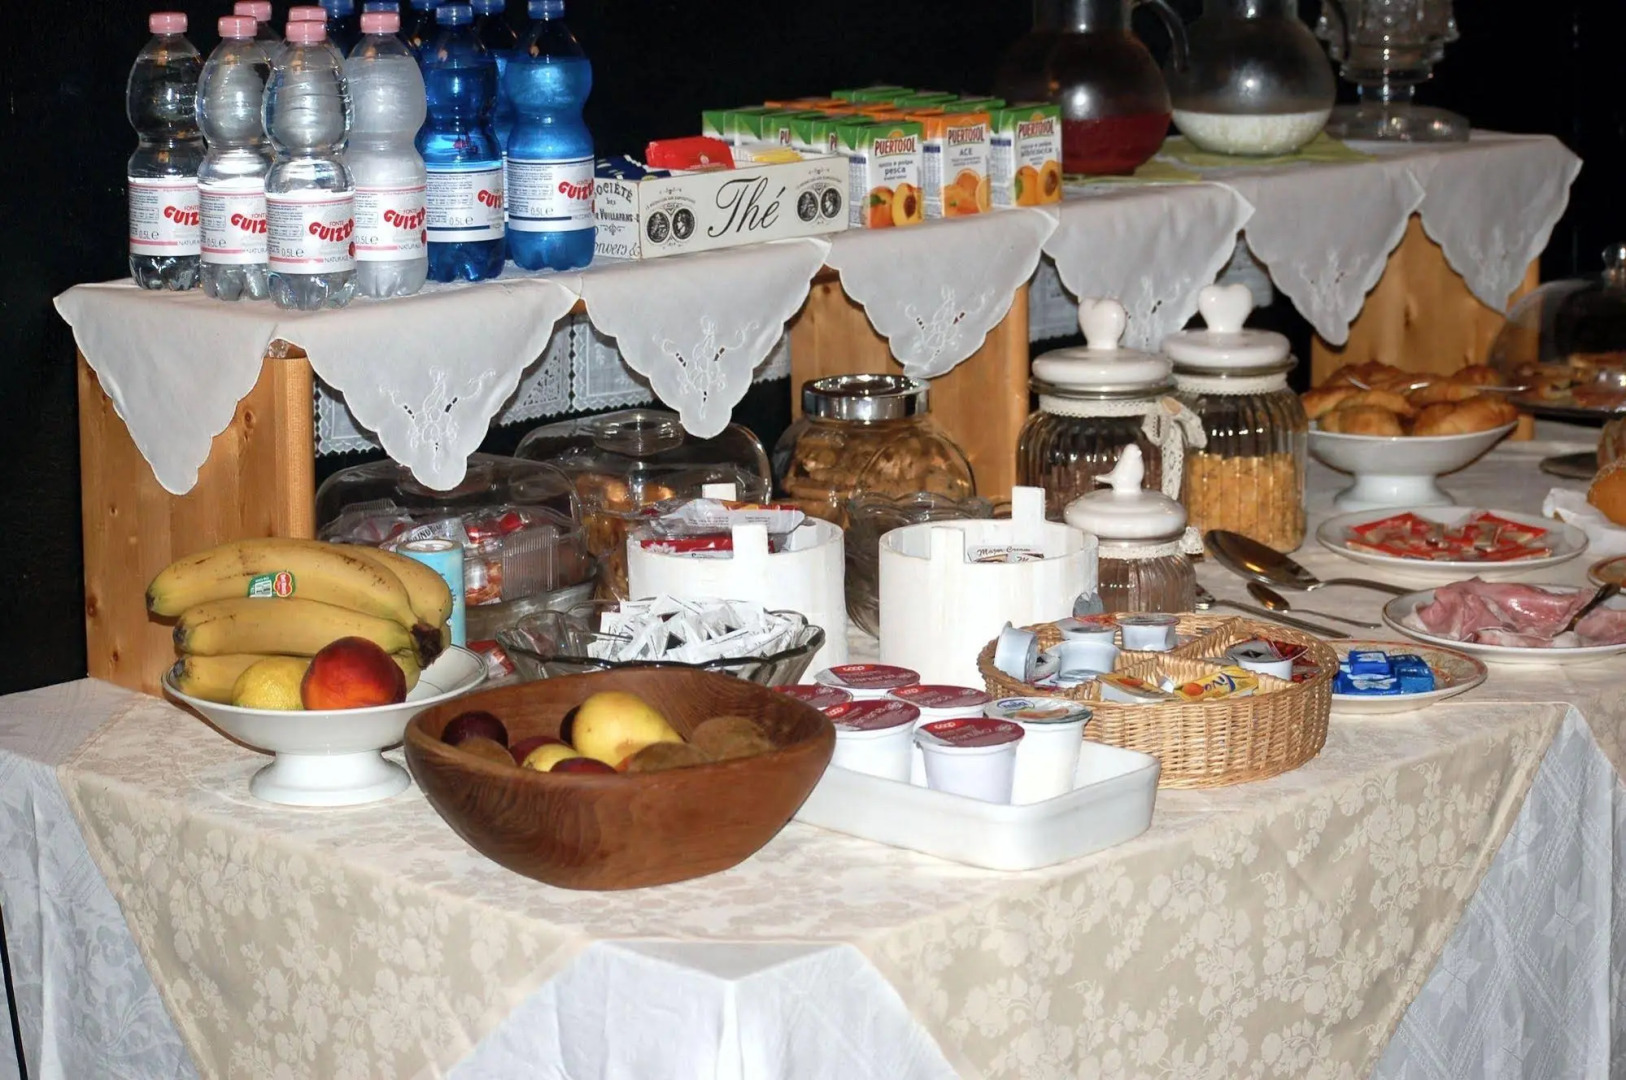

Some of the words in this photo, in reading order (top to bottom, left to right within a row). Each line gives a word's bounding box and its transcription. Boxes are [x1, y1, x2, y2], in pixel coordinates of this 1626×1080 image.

[948, 125, 985, 146] PUERTOSOL
[874, 137, 917, 157] PUERTOSOL
[959, 148, 973, 156] ACE
[884, 166, 906, 177] pesca
[708, 176, 786, 238] Thé
